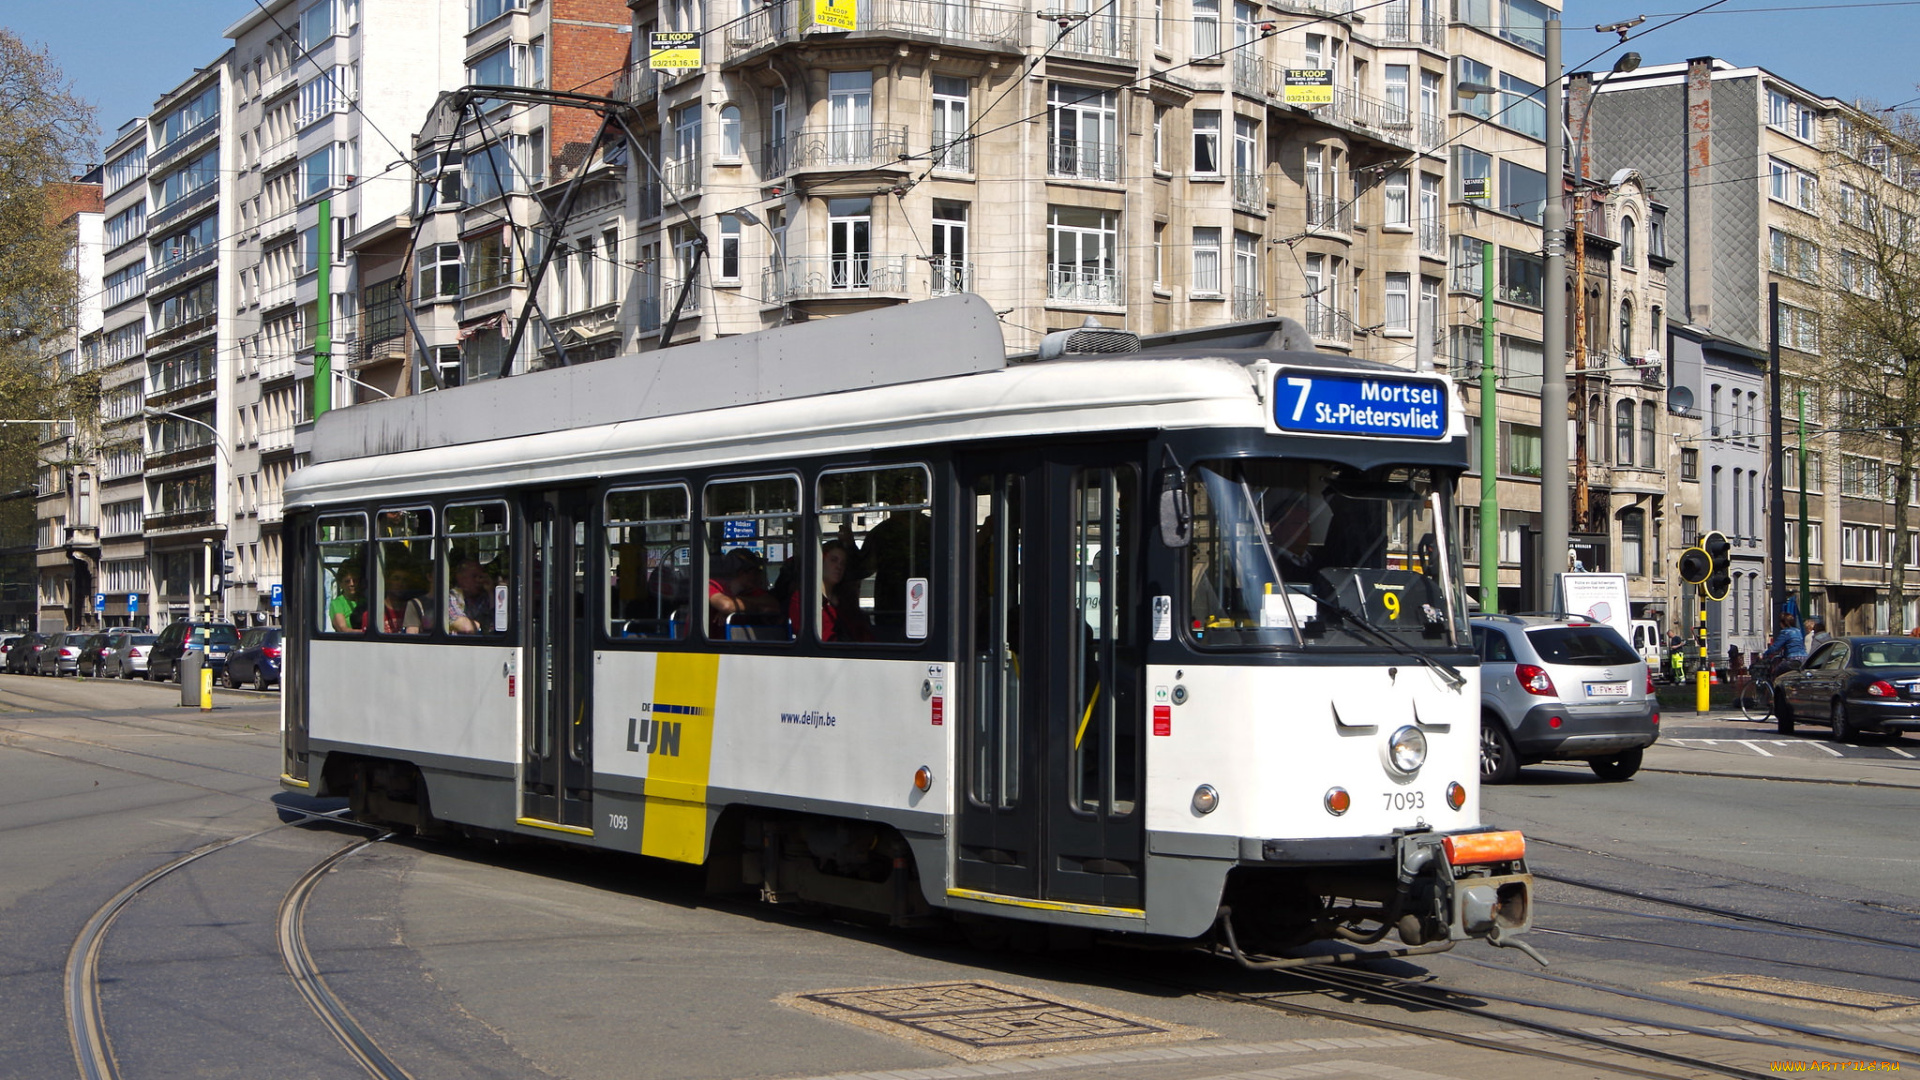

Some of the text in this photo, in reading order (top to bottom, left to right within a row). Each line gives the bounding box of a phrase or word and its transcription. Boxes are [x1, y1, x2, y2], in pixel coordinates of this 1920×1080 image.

[669, 33, 694, 41] KOOP
[1287, 377, 1312, 421] 7
[1361, 381, 1438, 405] Mortsel
[1315, 402, 1439, 429] St.-Pietersvliet
[96, 595, 104, 605] P
[129, 595, 137, 605] P
[272, 586, 282, 598] P
[1383, 592, 1400, 620] 9
[641, 702, 651, 712] DE
[780, 710, 836, 728] www.delijn.be
[626, 717, 682, 757] LIJN
[1383, 791, 1425, 810] 7093
[609, 814, 628, 830] 7093
